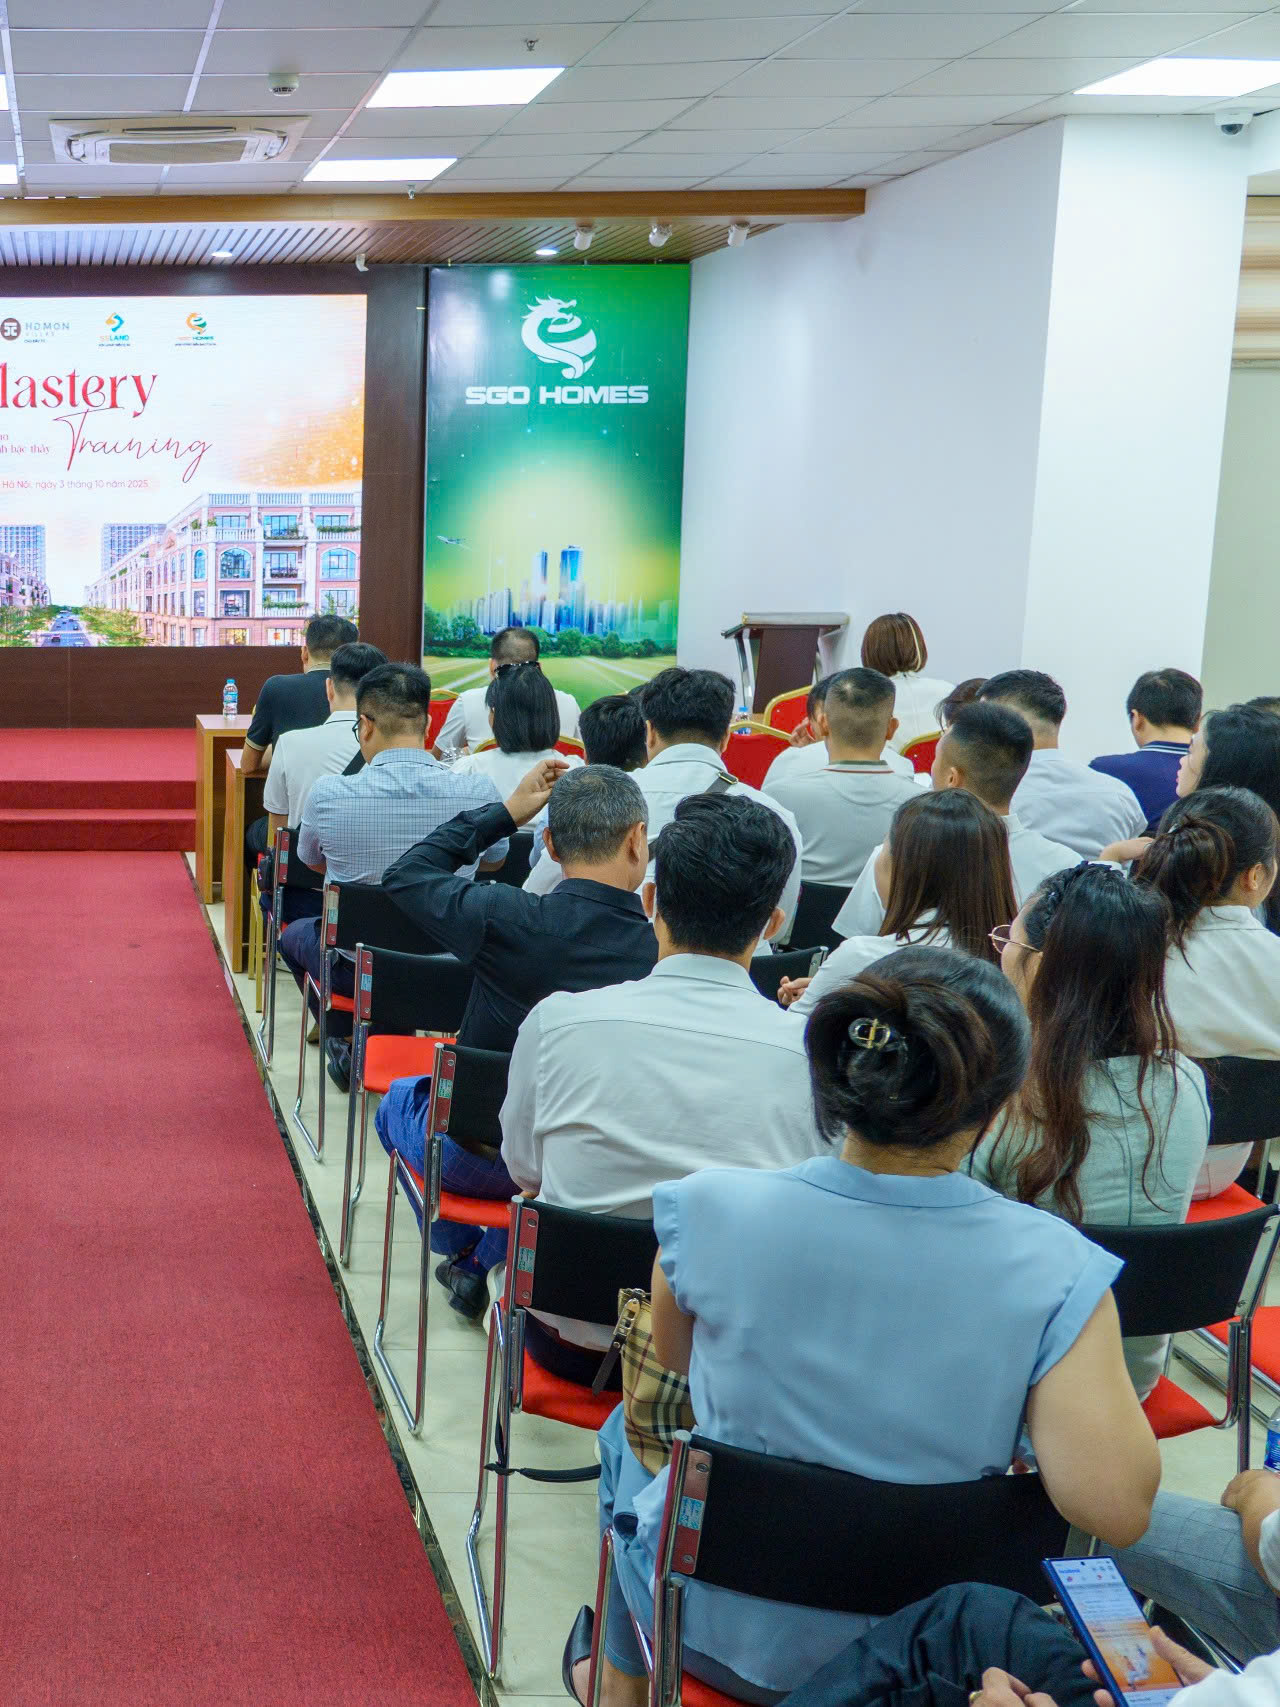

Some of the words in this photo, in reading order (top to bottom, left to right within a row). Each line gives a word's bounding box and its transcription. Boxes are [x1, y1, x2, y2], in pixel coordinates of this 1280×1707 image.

[465, 385, 531, 405] SGO
[539, 385, 649, 405] HOMES
[52, 408, 213, 484] Training
[2, 479, 15, 489] Hà
[35, 480, 57, 491] ngày
[59, 480, 65, 489] 3
[66, 479, 93, 491] tháng
[95, 480, 104, 489] 10
[127, 479, 149, 489] 2025
